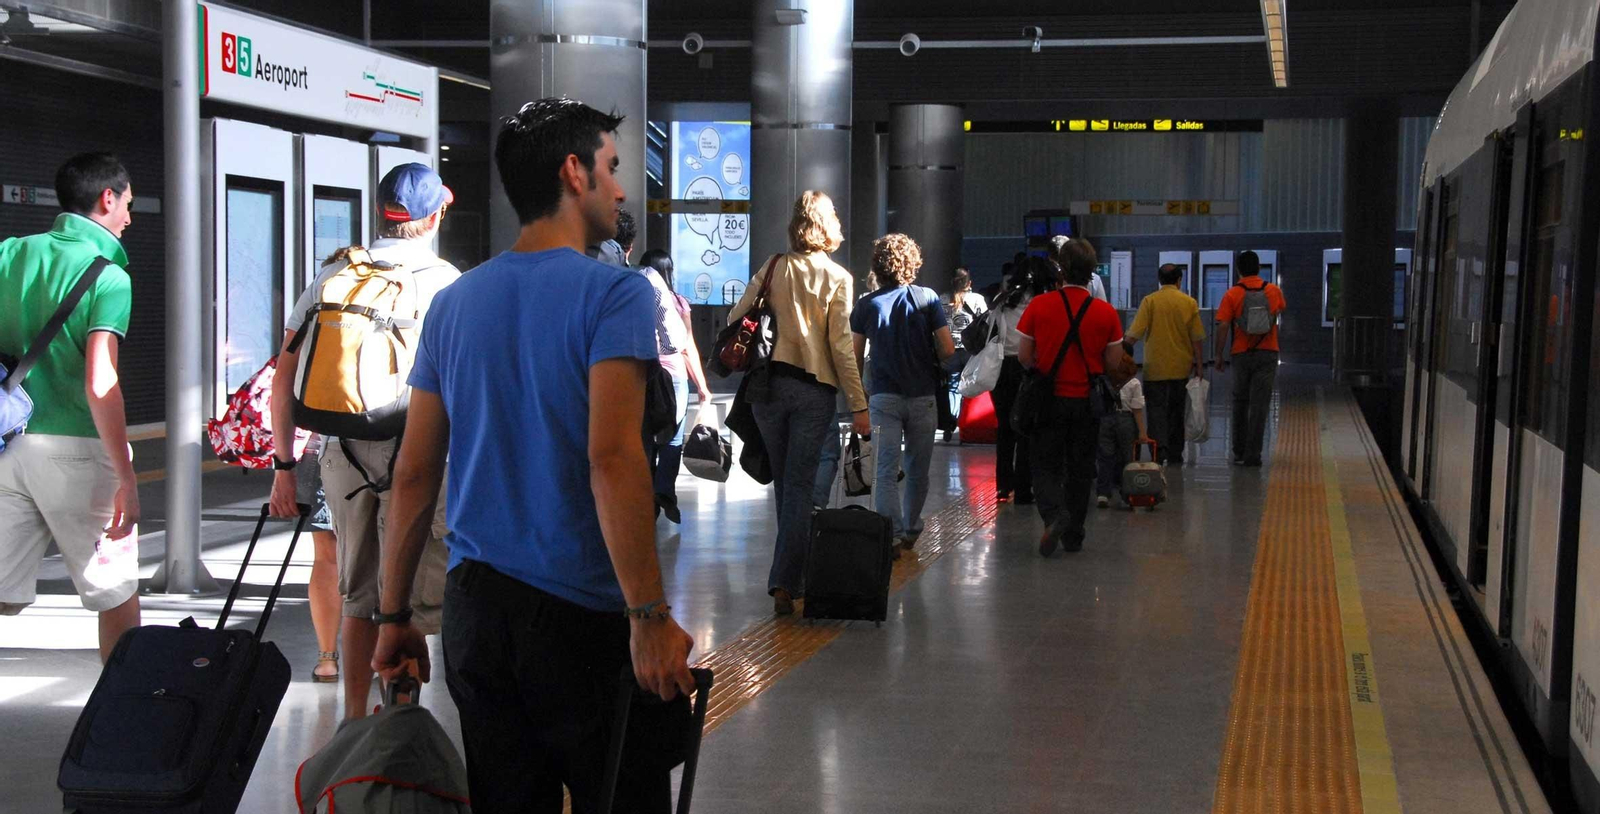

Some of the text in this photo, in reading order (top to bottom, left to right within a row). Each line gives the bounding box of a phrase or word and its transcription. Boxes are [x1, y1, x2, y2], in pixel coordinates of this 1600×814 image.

[224, 36, 235, 69] 3
[239, 40, 250, 72] 5
[255, 53, 308, 91] Aeroport
[1113, 121, 1204, 130] Llegadas Salidas
